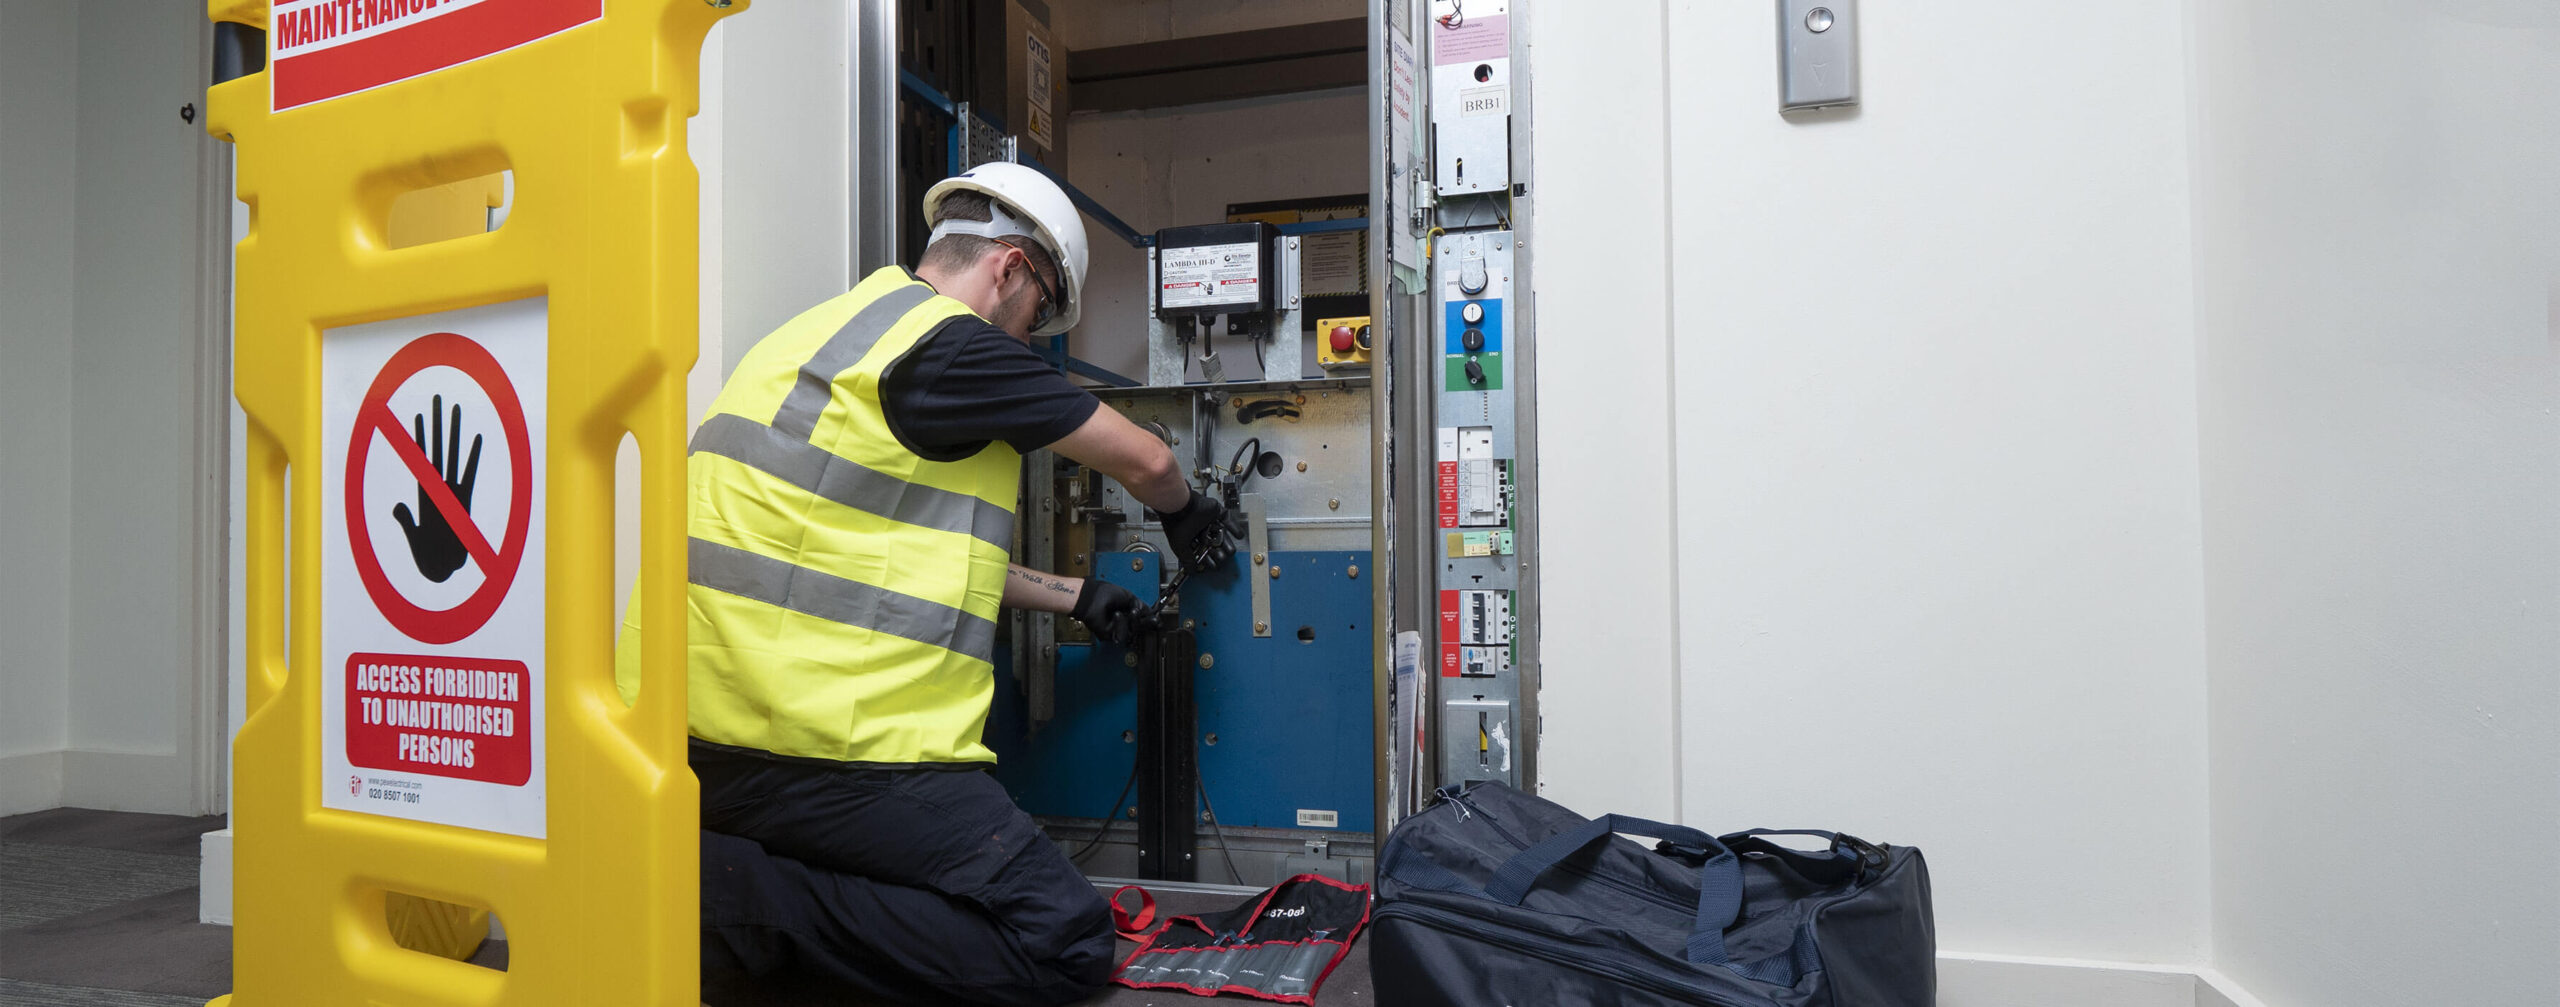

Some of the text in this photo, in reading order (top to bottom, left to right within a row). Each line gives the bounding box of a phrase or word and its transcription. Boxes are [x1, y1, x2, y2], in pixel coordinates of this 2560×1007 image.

[277, 0, 438, 51] MAINTENAN
[1028, 36, 1050, 65] OTIS
[1465, 98, 1500, 113] BRB1
[1164, 258, 1216, 269] LAMBDA III-D
[1509, 615, 1517, 640] OFF
[356, 663, 519, 702] ACCESS FORBIDDEN
[361, 697, 515, 738] TO UNAUTHORISED
[398, 733, 475, 769] PERSONS
[368, 788, 421, 804] 020 8507 1001
